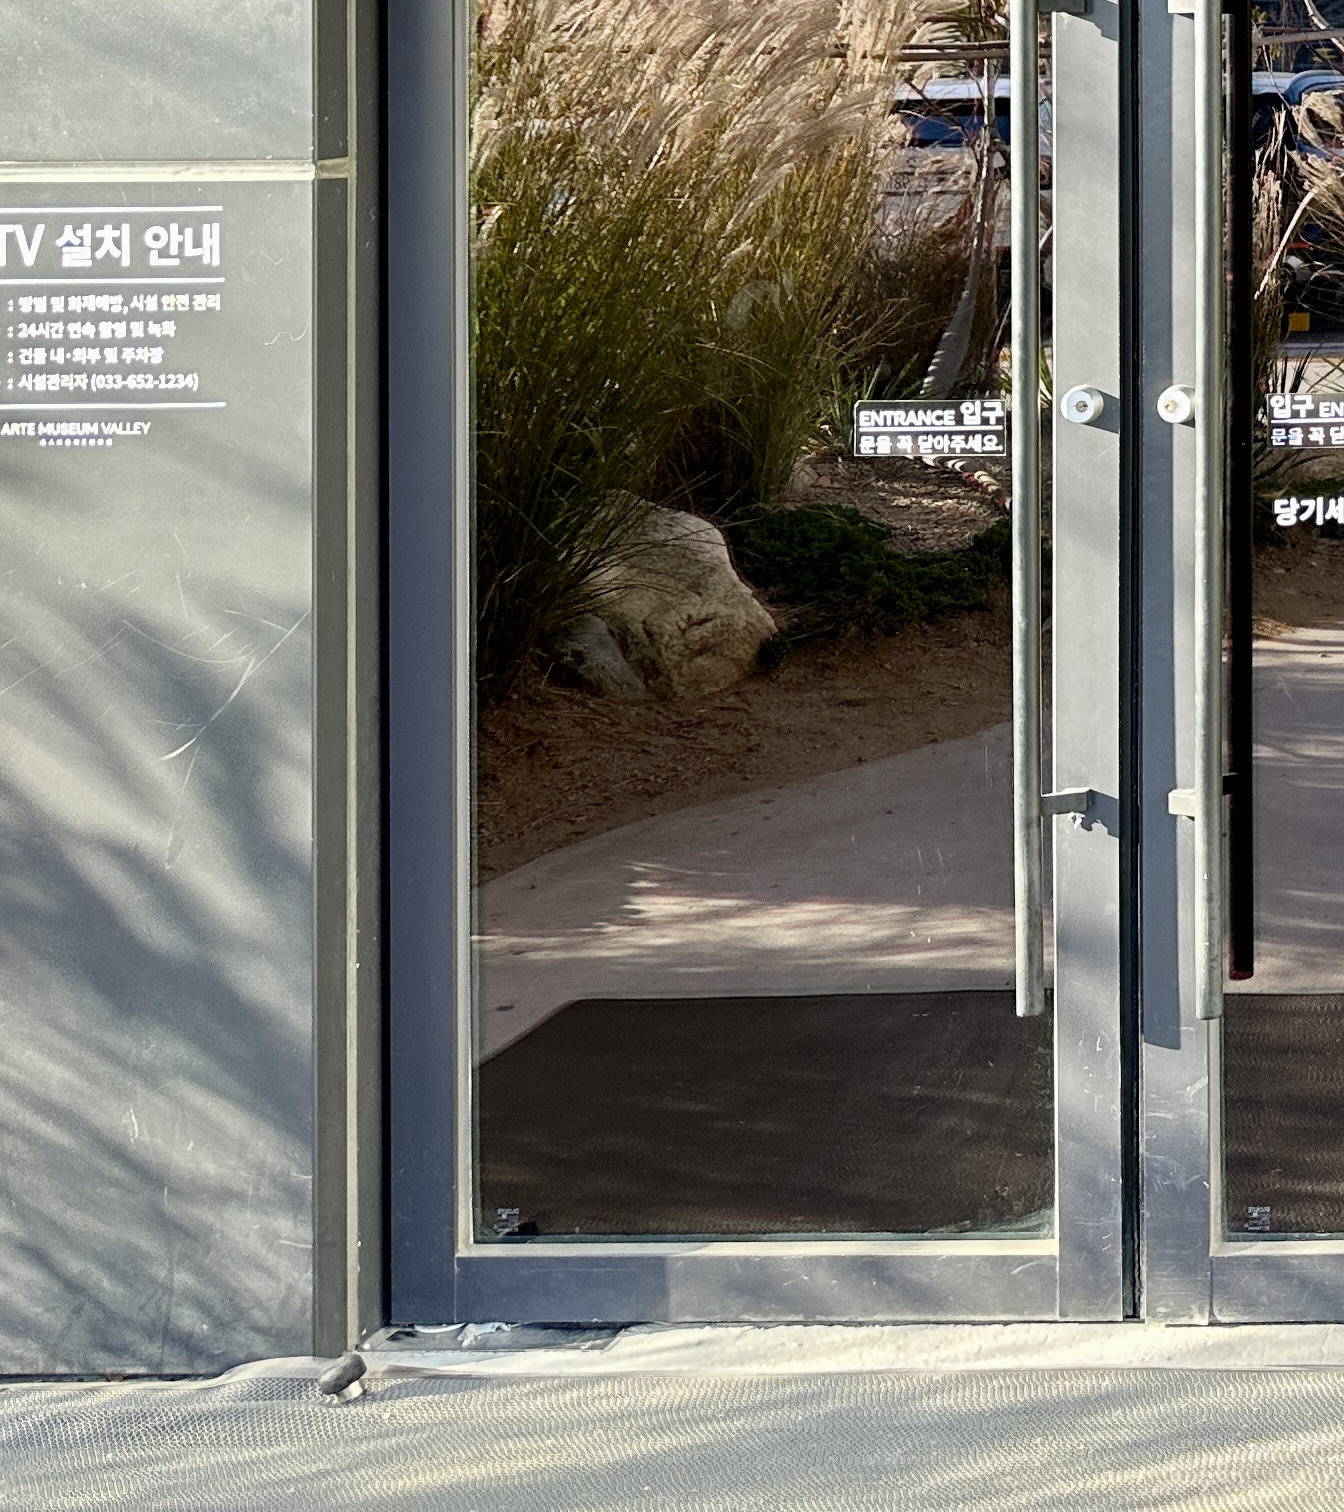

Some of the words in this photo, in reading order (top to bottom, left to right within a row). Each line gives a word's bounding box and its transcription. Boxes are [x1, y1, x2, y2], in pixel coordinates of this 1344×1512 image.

[55, 223, 131, 268] 설치
[143, 222, 221, 267] 안내
[50, 295, 65, 313] 및
[129, 294, 159, 312] 시설
[160, 293, 190, 312] 안전
[192, 293, 221, 311] 관리
[17, 321, 65, 339] 24시간
[66, 321, 96, 339] 연속
[129, 320, 145, 338] 및
[103, 346, 119, 364] 및
[120, 346, 165, 365] 주차장
[90, 372, 199, 392] (033-652-1234)
[859, 409, 956, 427] ENTRANCE
[960, 399, 1004, 425] 입구
[1270, 393, 1315, 419] 입구
[0, 421, 36, 436] ARTE
[37, 421, 99, 436] MUSEUM
[100, 421, 152, 435] VALLEY
[1270, 427, 1304, 446] 문을
[1307, 426, 1326, 445] 꼭
[859, 435, 893, 454] 문을
[896, 435, 914, 454] 꼭
